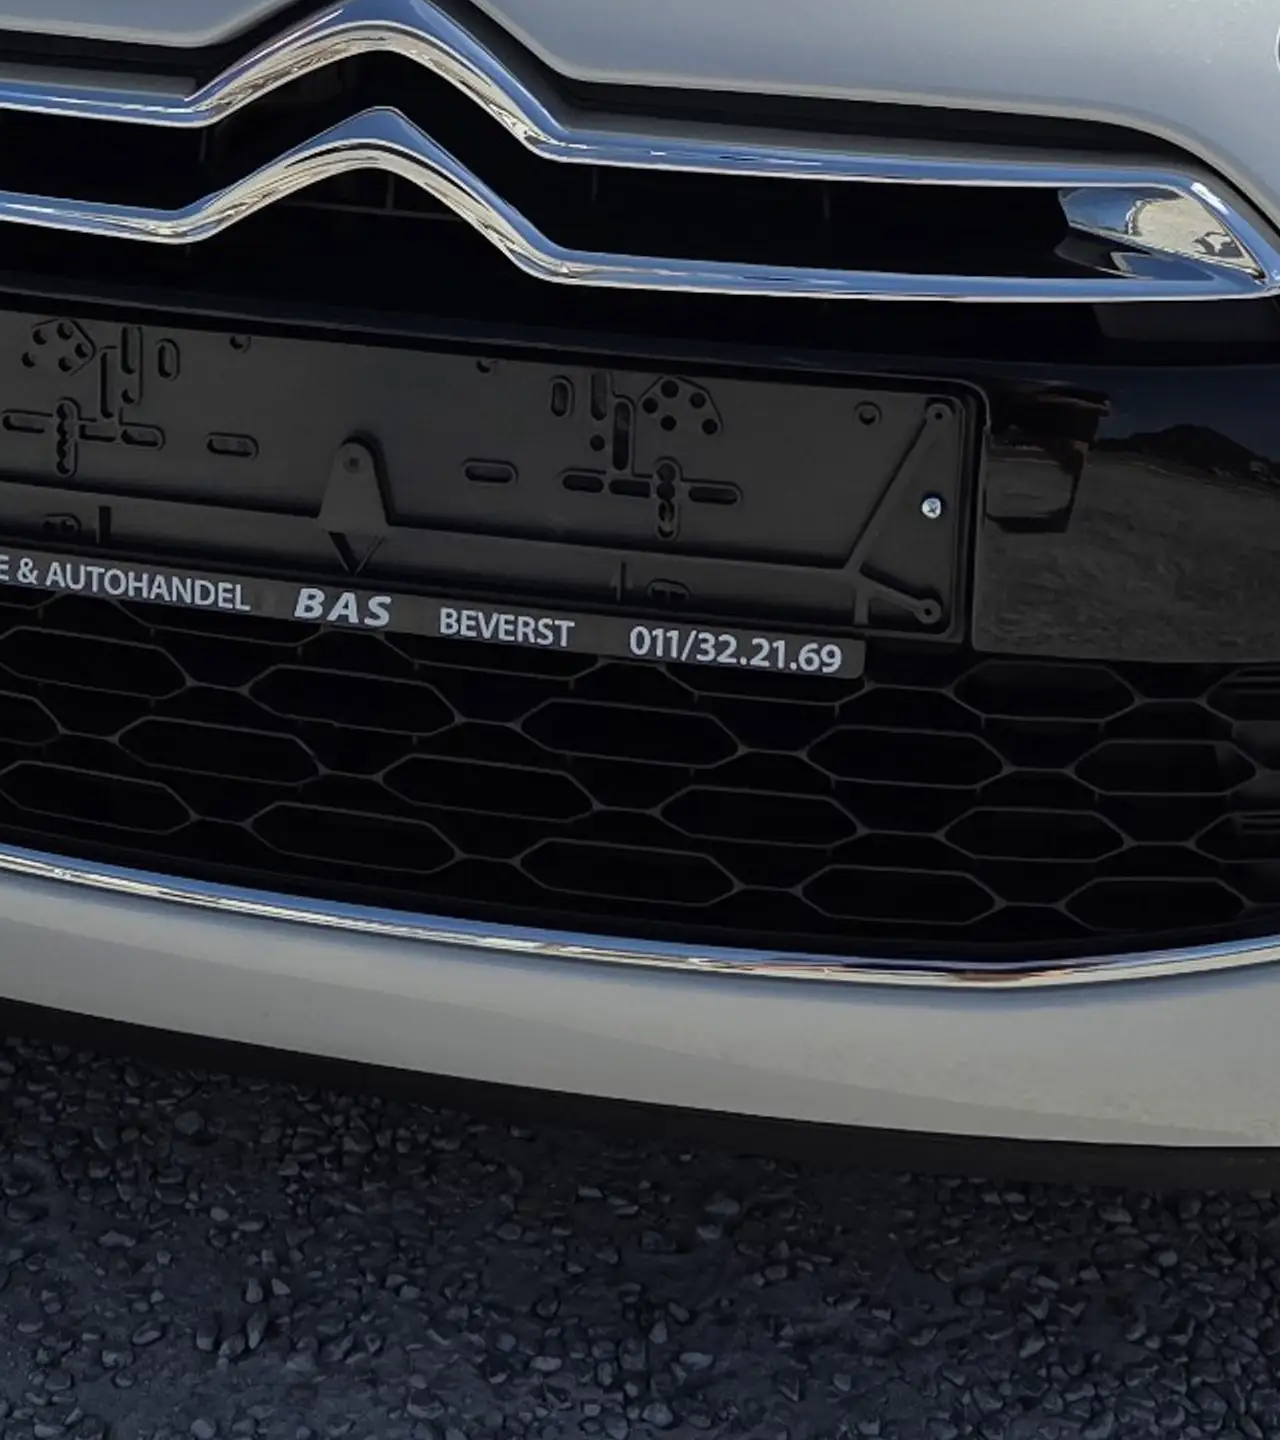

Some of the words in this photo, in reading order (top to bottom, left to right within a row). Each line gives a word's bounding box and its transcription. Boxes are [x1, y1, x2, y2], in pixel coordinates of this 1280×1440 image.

[17, 558, 38, 584] &
[45, 561, 252, 612] AUTOHANDEL
[294, 588, 392, 627] BAS
[440, 608, 575, 647] BEVERST
[629, 626, 842, 674] 011/32.21.69
